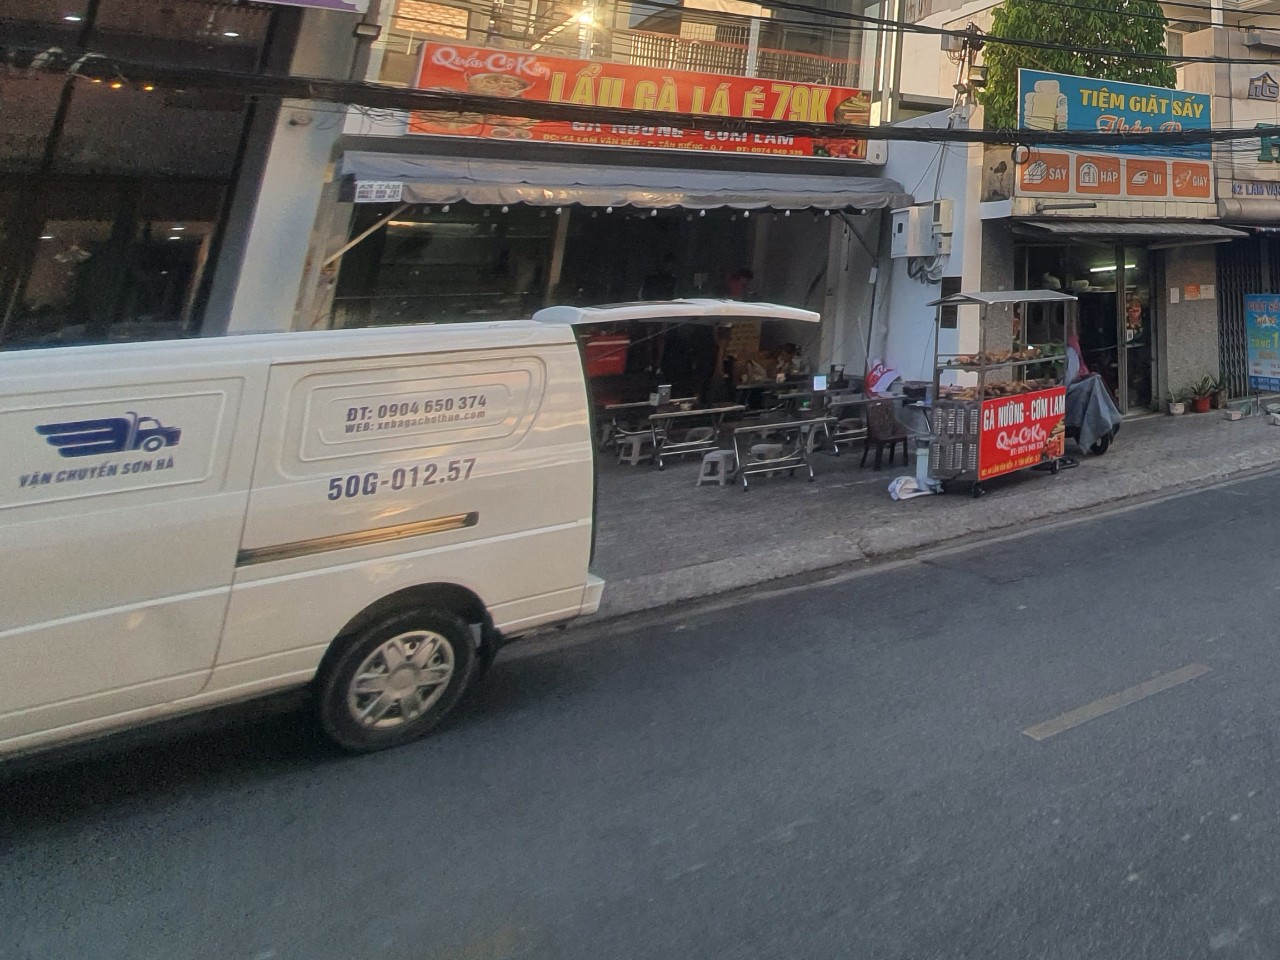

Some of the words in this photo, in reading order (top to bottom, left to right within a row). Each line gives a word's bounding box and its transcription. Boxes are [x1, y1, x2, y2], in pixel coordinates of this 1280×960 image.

[549, 62, 626, 107] LẨU
[633, 77, 678, 113] GÀ
[692, 83, 731, 118] LÁ
[743, 86, 766, 119] É
[769, 83, 832, 124] 79K
[1079, 87, 1125, 111] TIỆM
[1129, 94, 1168, 117] GIẶT
[1172, 96, 1204, 118] SẤY
[1049, 165, 1067, 181] SẤY
[1101, 167, 1118, 183] HẤP
[346, 406, 373, 422] ĐT:
[377, 401, 419, 418] 0904
[424, 397, 454, 413] 650
[458, 395, 486, 410] 374
[983, 404, 995, 431] GÀ
[997, 400, 1025, 428] NƯỚNG
[1031, 396, 1048, 421] CƠM
[1050, 394, 1066, 417] LAM
[345, 421, 374, 433] WEB:
[327, 458, 476, 501] 50G-012.57
